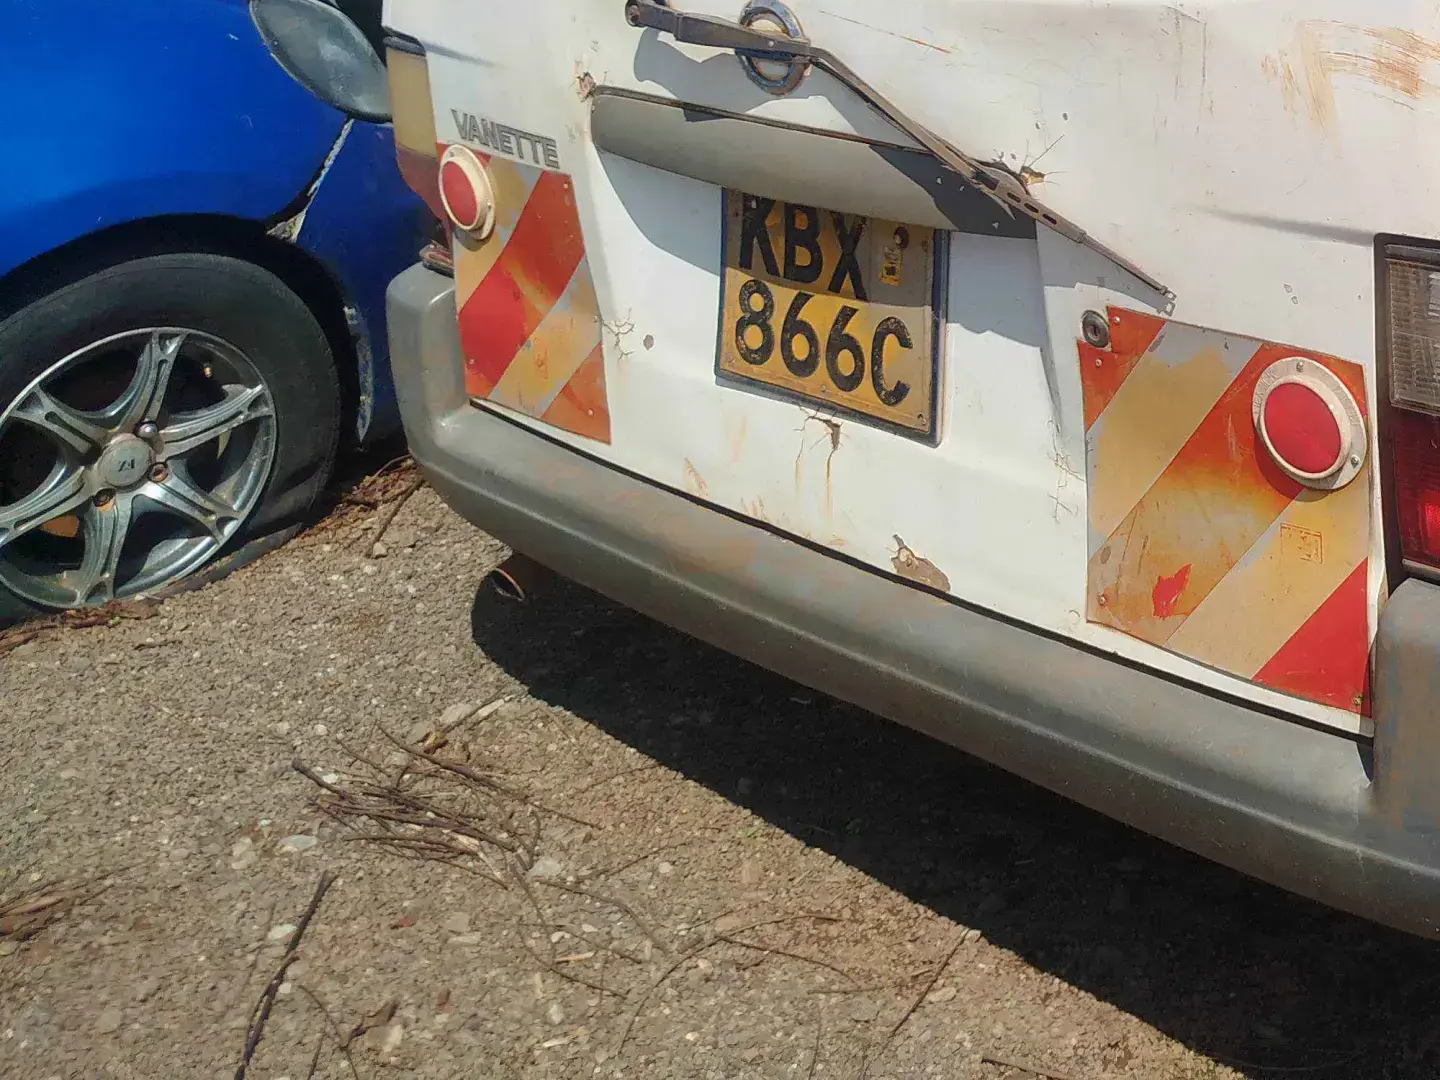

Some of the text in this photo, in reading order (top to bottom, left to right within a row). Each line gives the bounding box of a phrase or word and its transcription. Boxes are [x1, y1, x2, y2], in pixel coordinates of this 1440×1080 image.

[450, 108, 561, 170] VANETTE
[739, 192, 869, 302] KBX
[735, 279, 914, 406] 866C
